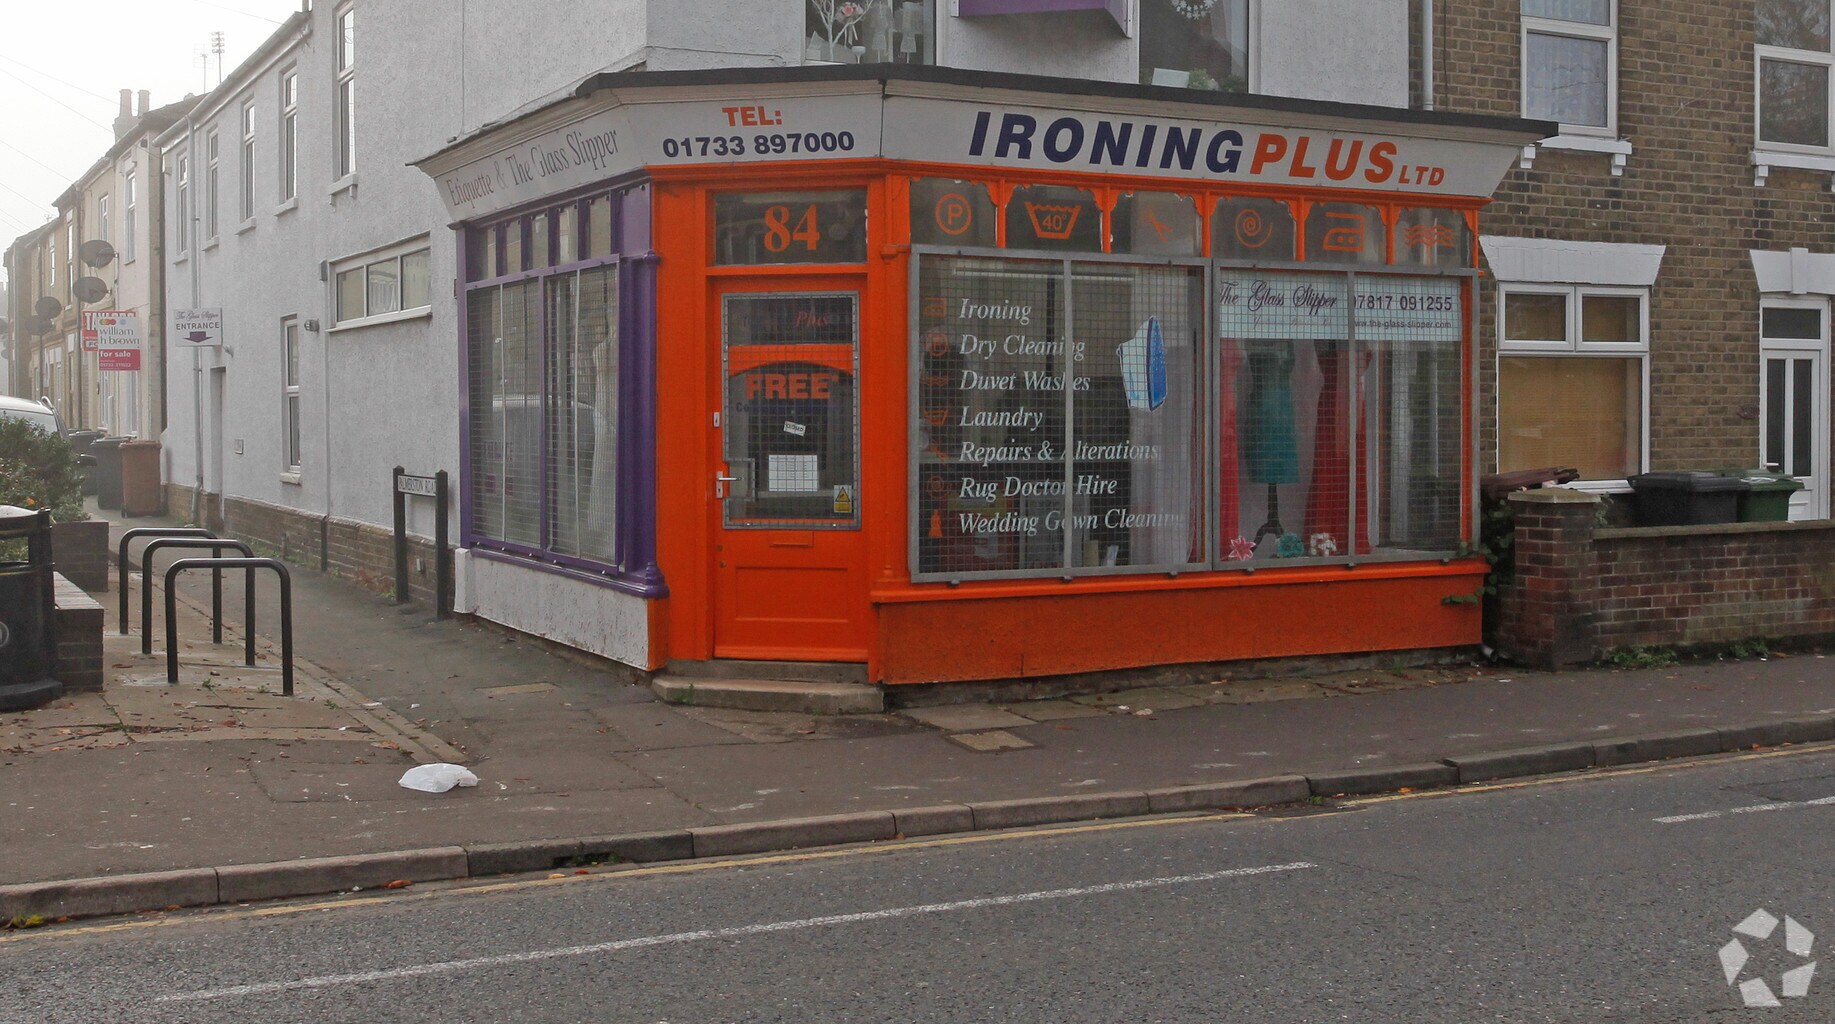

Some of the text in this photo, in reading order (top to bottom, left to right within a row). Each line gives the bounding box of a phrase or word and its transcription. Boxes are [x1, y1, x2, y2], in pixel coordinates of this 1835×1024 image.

[722, 106, 782, 127] TEL:
[662, 131, 855, 158] 01733 897000
[446, 129, 620, 209] Etiquette & The Glass Slipper
[1399, 164, 1446, 187] LTD
[763, 204, 821, 253] 84
[1220, 279, 1338, 315] The Glass Slipper
[1354, 295, 1453, 311] 7817 091255
[959, 298, 1032, 325] Ironing
[100, 326, 134, 336] william
[175, 321, 220, 331] ENTRANCE
[108, 335, 140, 345] brown
[959, 333, 997, 360] Dry
[100, 350, 131, 358] for sale
[959, 370, 1017, 391] Duvet
[959, 406, 1043, 431] Laundry
[959, 438, 1032, 467] Repairs
[1037, 440, 1053, 461] &
[959, 477, 998, 503] Rug
[1076, 474, 1118, 495] Hire
[959, 511, 1040, 536] Wedding
